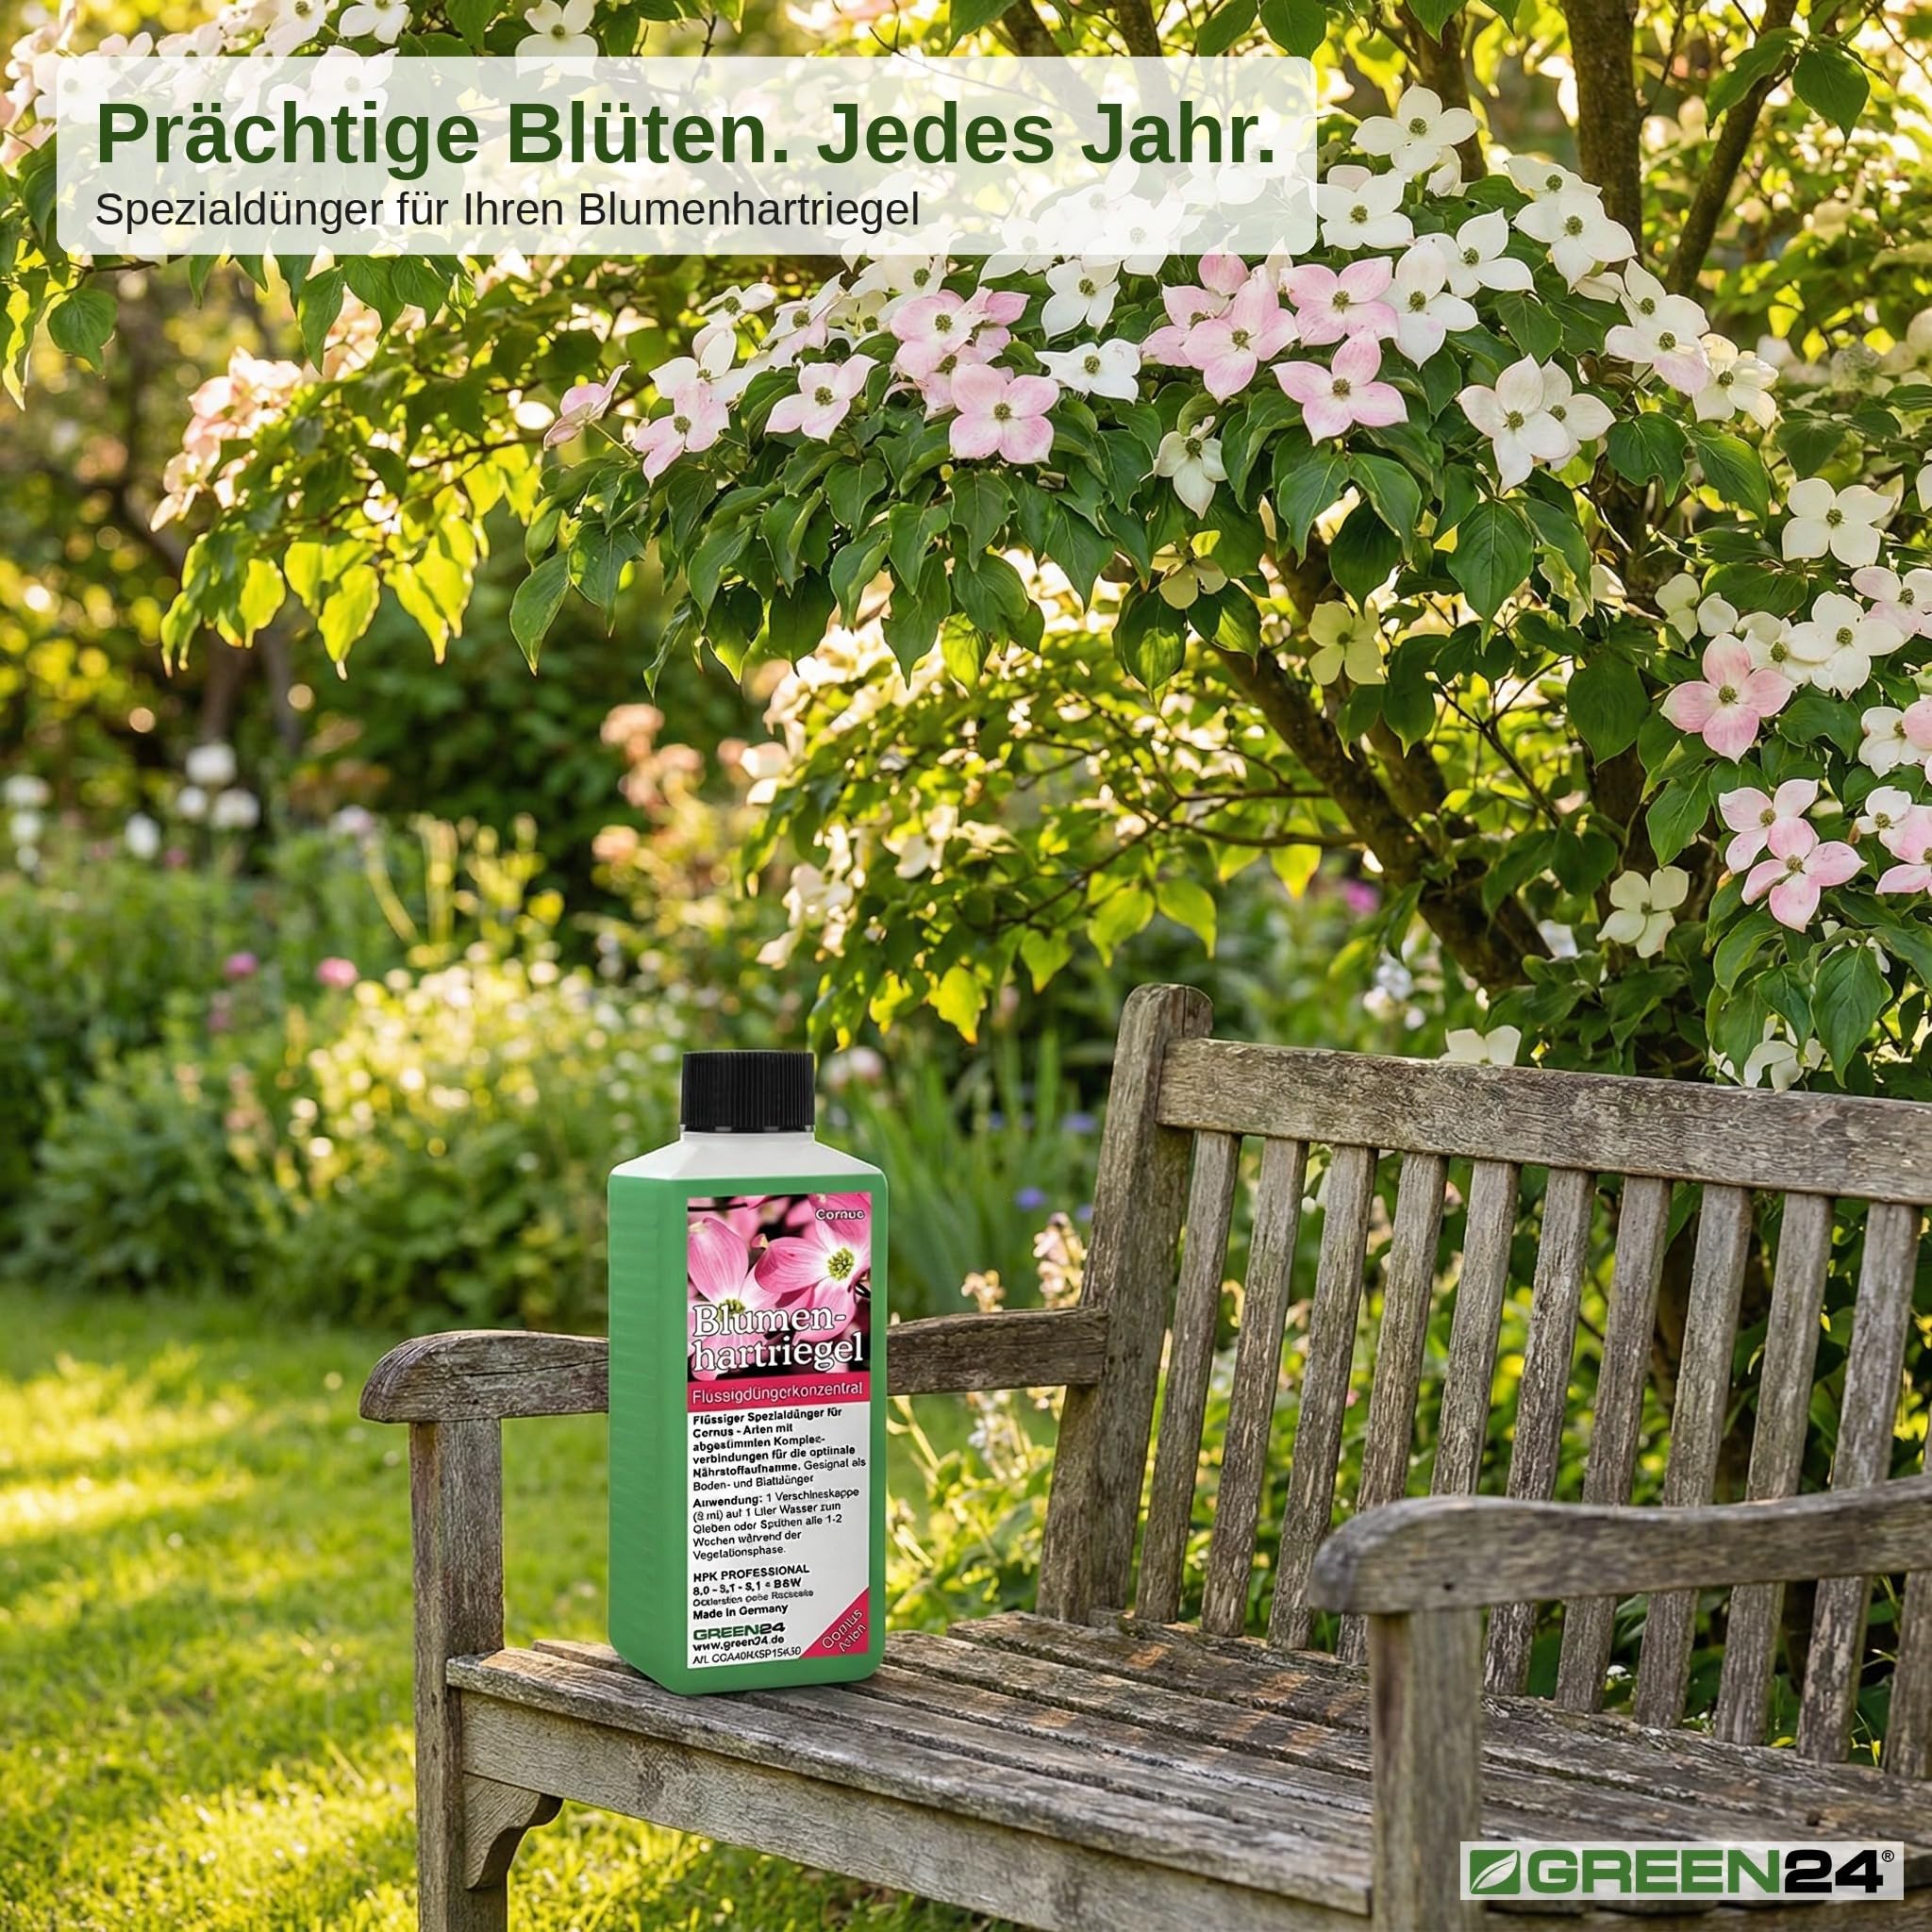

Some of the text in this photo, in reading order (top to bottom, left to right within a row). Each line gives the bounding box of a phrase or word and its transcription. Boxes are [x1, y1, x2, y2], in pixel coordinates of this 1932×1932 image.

[693, 1304, 846, 1337] Blumen-
[692, 1332, 863, 1373] hartriegel
[775, 1423, 793, 1433] mit
[772, 1449, 788, 1459] für
[790, 1448, 807, 1457] die
[733, 1478, 753, 1488] und
[784, 1530, 802, 1540] der
[721, 1564, 810, 1580] PROFESSIONAL
[692, 1608, 723, 1620] Made
[693, 1622, 786, 1641] GREEN24
